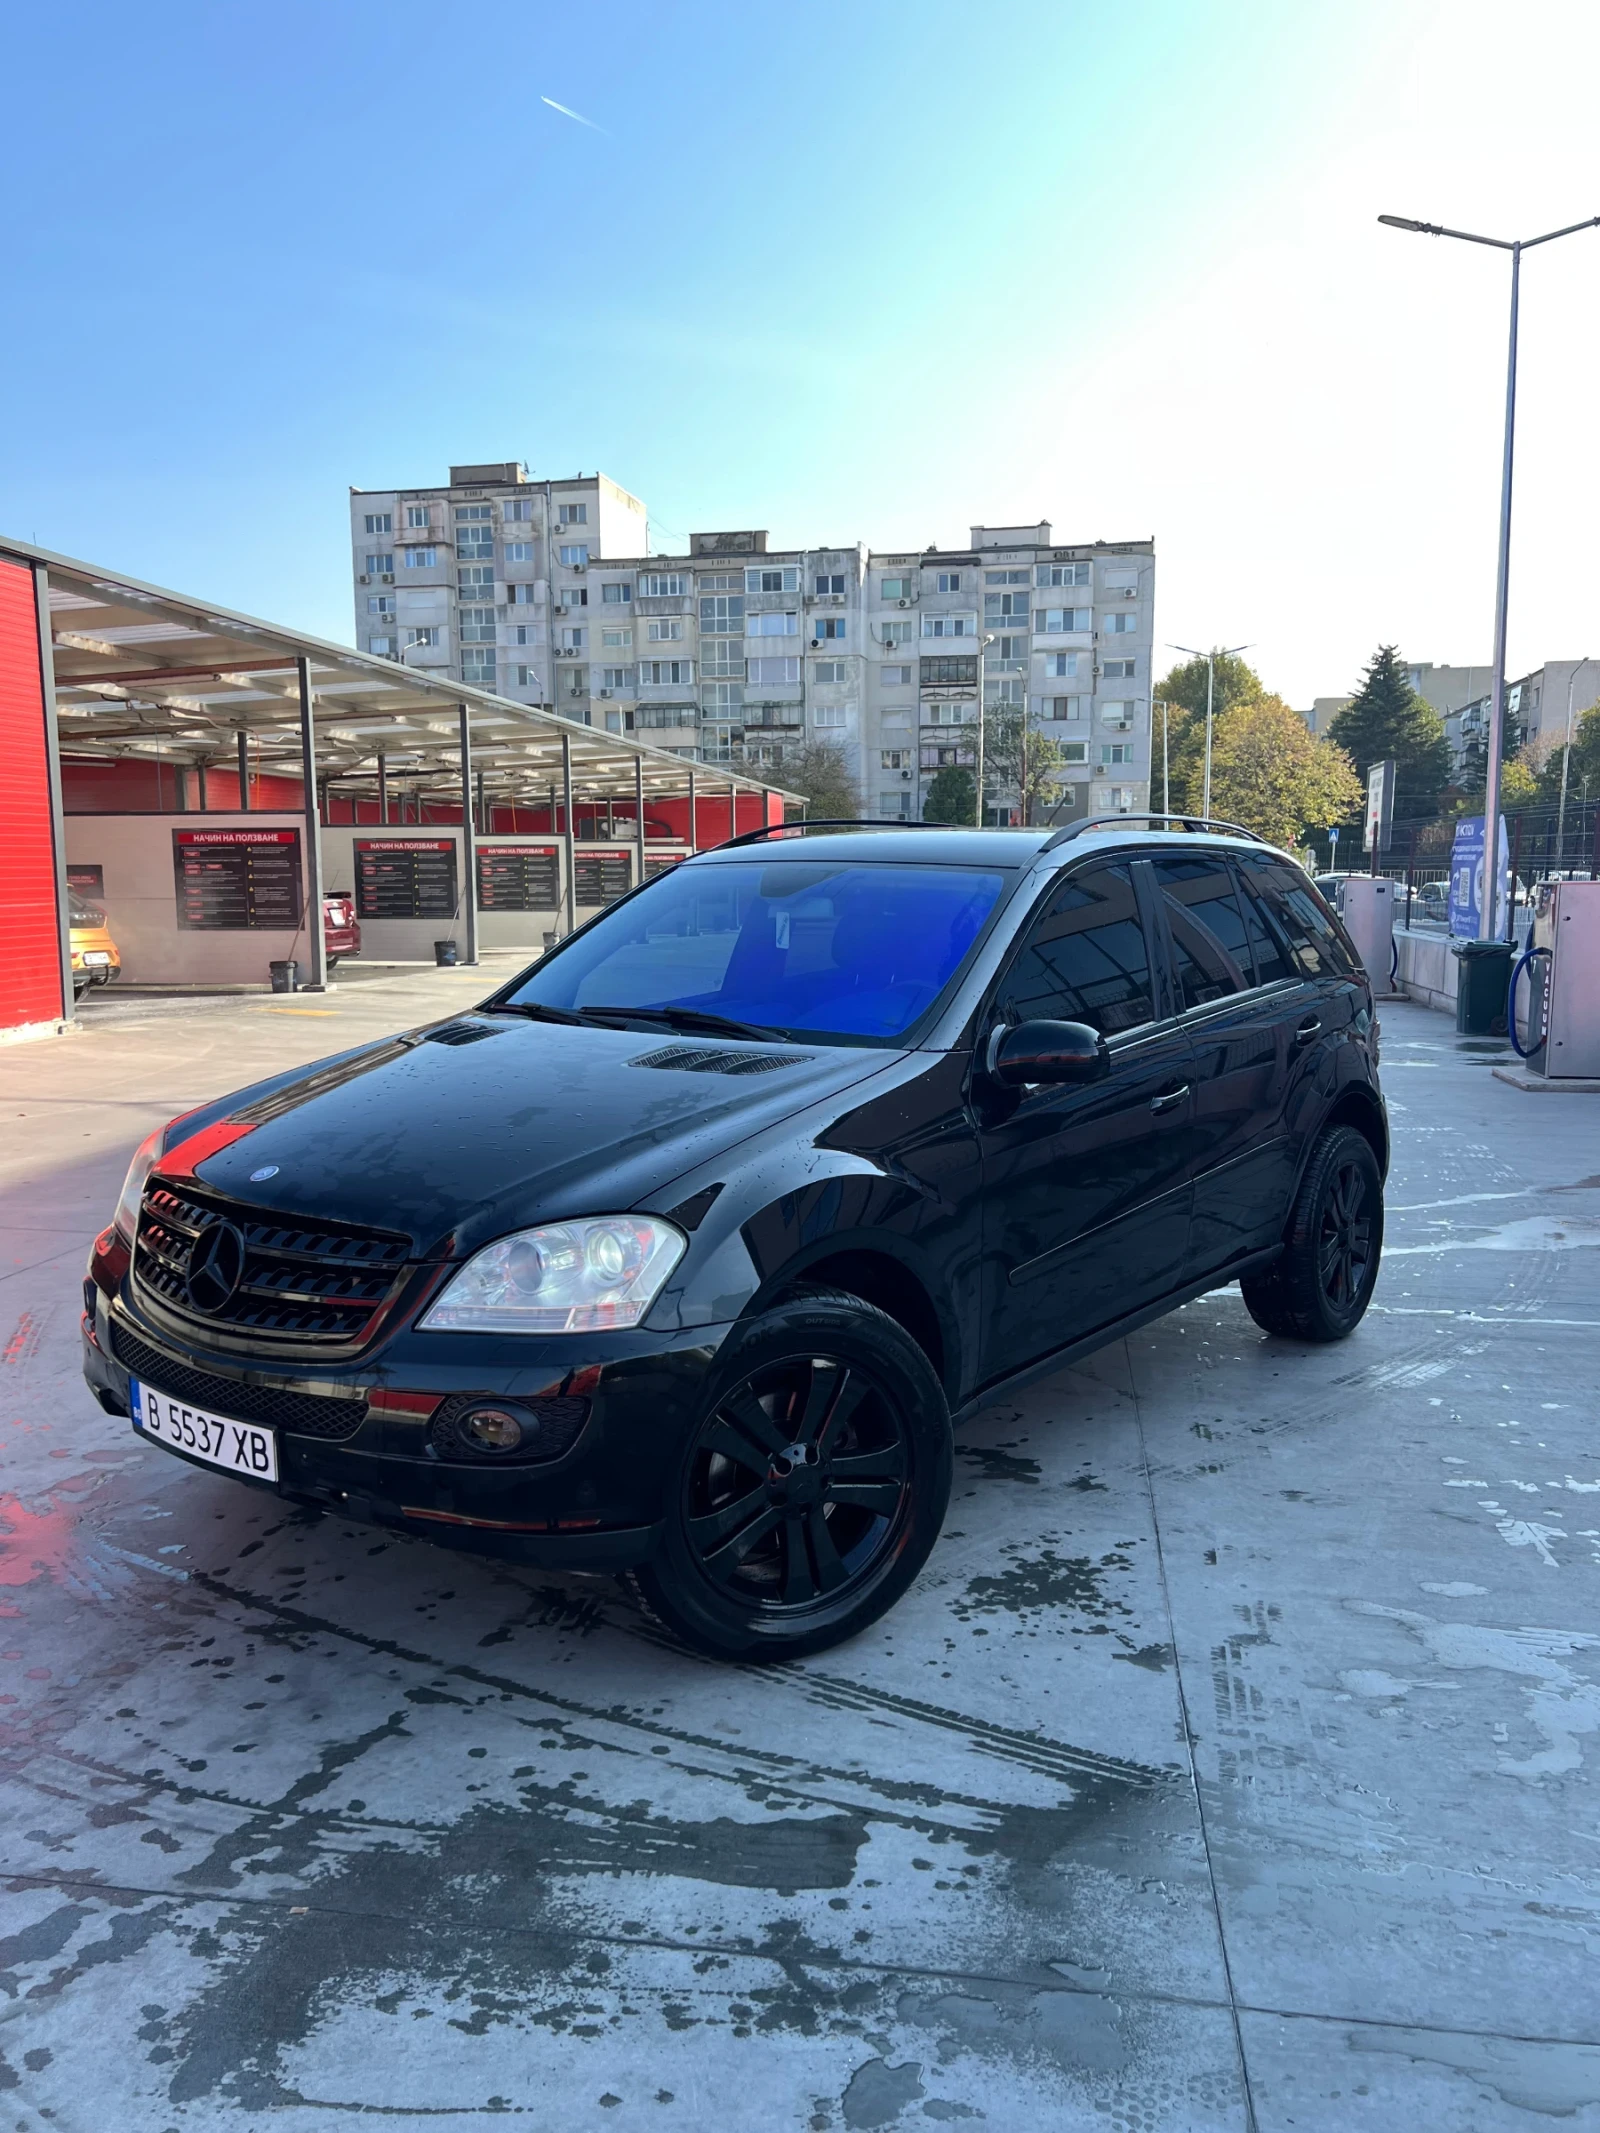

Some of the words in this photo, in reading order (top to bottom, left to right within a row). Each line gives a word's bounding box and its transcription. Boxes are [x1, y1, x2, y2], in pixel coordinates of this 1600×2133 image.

[193, 834, 221, 842] НАЧИН
[222, 834, 234, 842] НА
[235, 833, 279, 842] ПОЛЗВАНЕ
[1541, 962, 1551, 1036] VACUUM
[147, 1392, 160, 1431] B
[169, 1403, 225, 1458] 5537
[232, 1426, 269, 1472] XB
